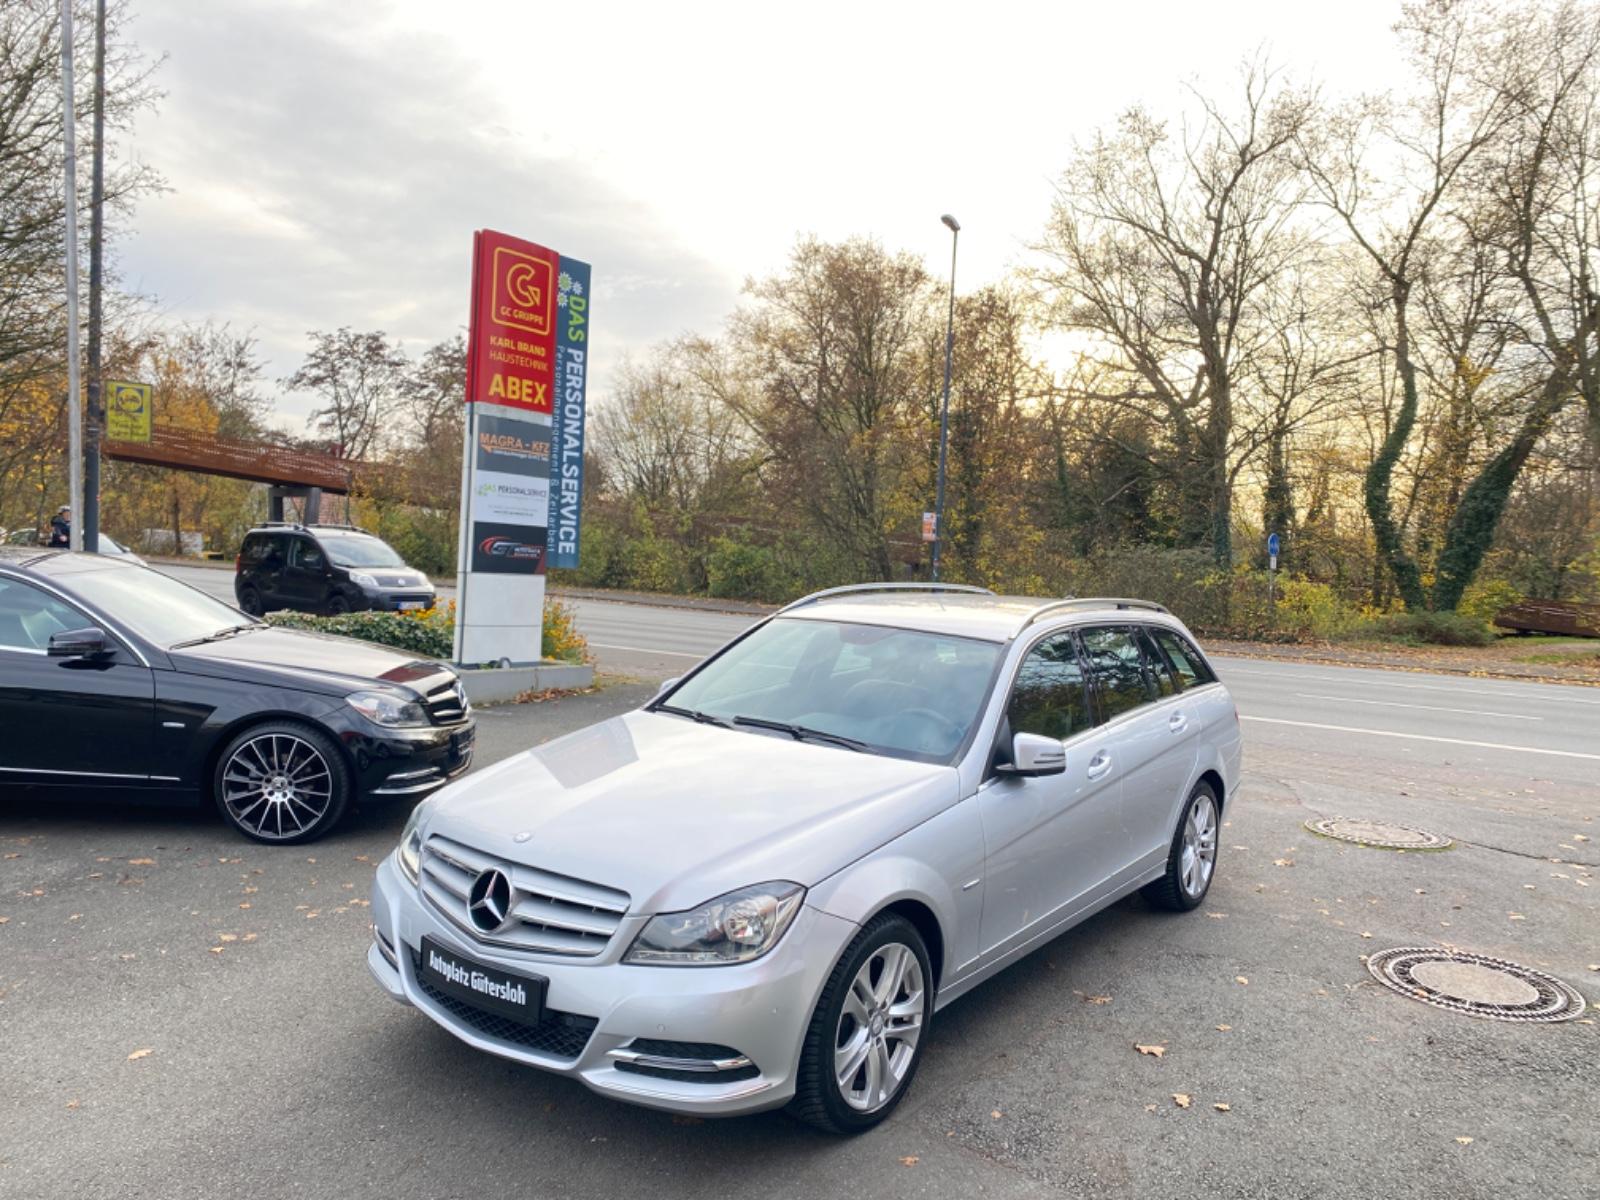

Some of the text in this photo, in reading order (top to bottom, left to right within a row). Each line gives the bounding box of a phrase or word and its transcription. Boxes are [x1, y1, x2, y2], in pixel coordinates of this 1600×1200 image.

[500, 306, 544, 326] GC GRUPPE
[489, 336, 546, 357] KARL BRAND
[489, 351, 548, 372] HAUSTECHNIK
[489, 374, 547, 406] ABEX
[552, 346, 565, 472] Personalmanagement
[558, 295, 586, 554] DAS PERSONALSERVICE
[479, 432, 523, 449] MAGRA
[497, 484, 547, 498] PERSONALSERVICE
[547, 493, 559, 552] Zeitarbeit
[429, 950, 526, 1006] Autoplatz Gütersloh
